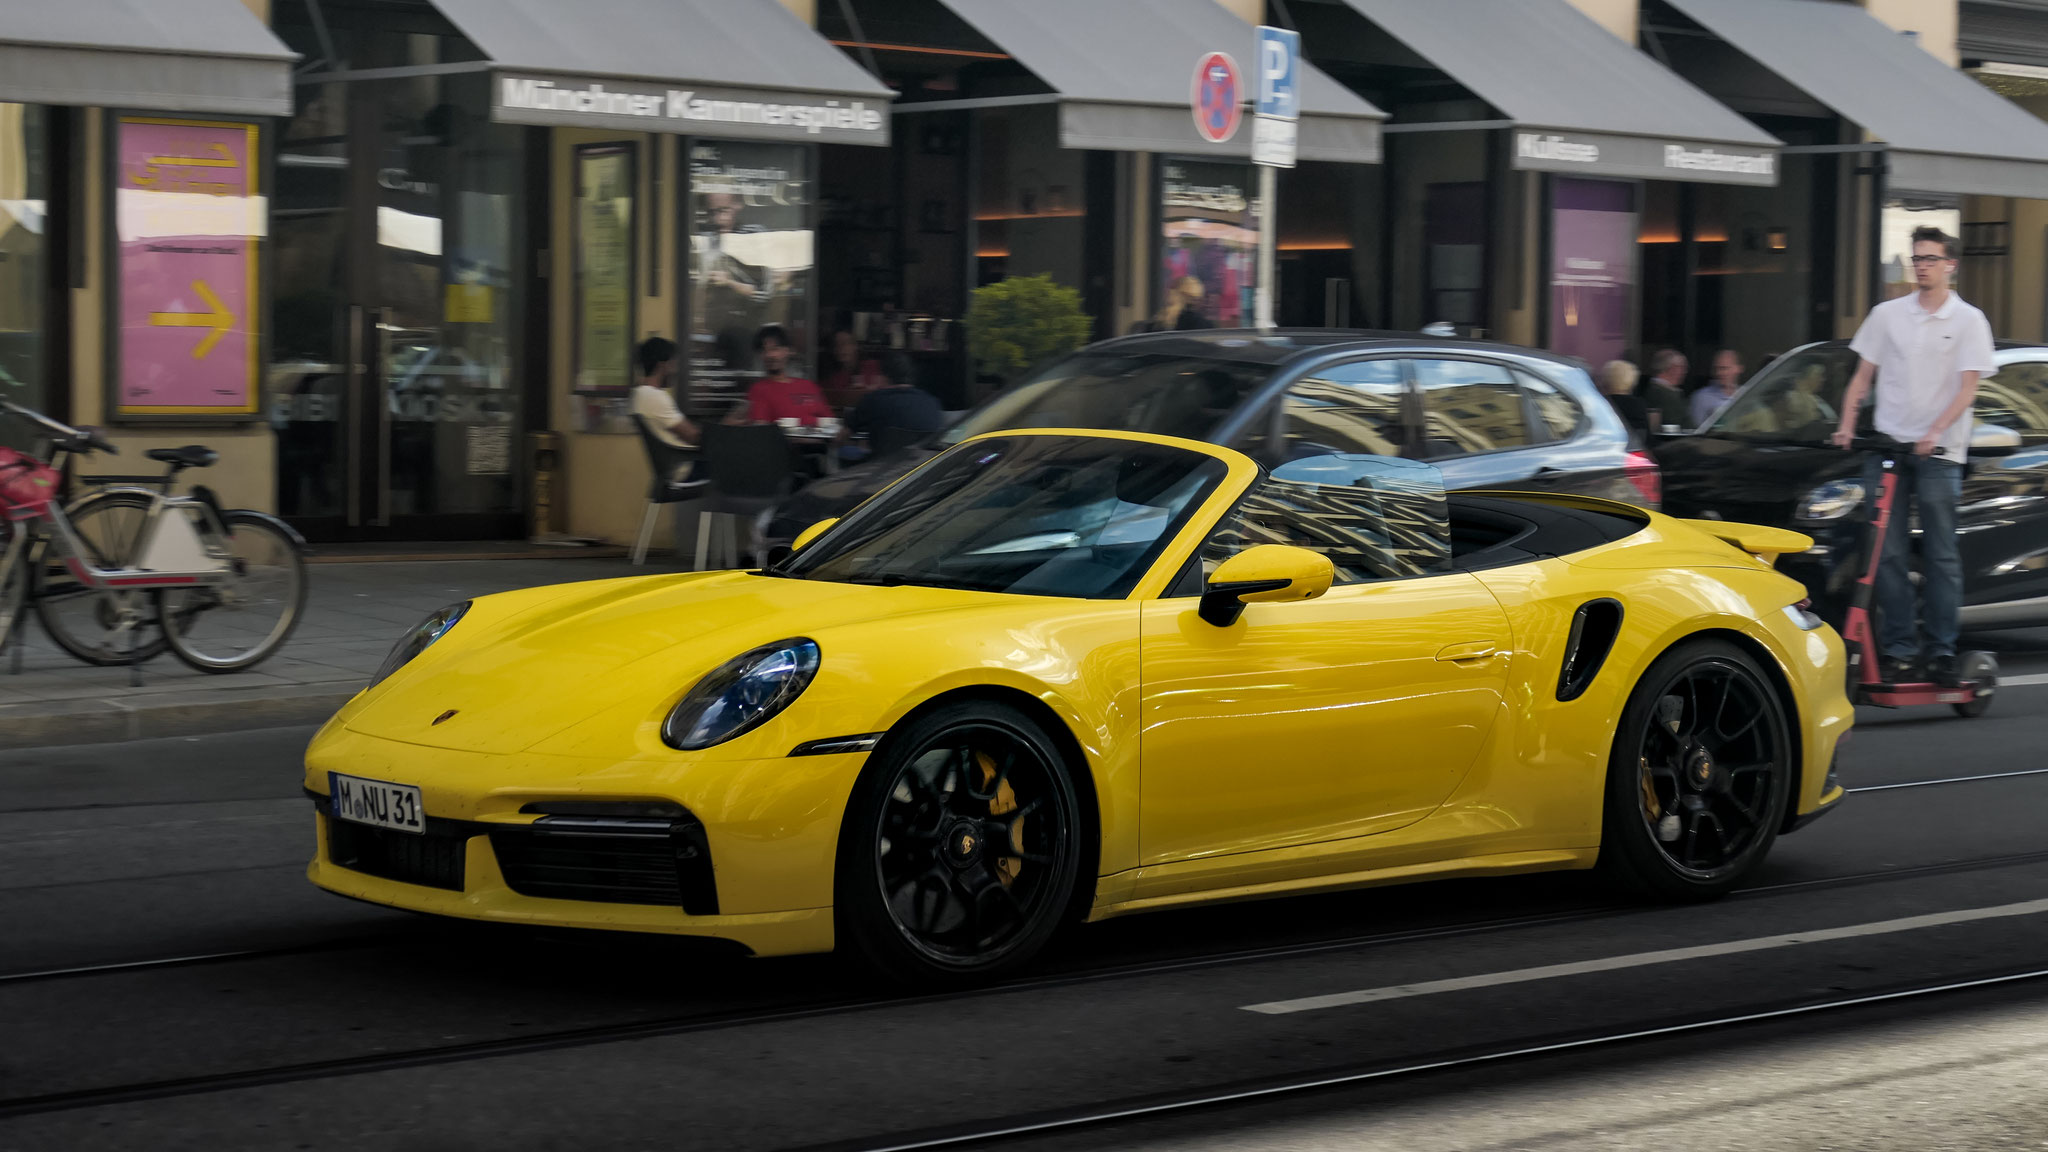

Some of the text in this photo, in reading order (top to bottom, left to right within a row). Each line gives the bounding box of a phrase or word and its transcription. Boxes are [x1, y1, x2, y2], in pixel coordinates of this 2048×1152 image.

[1261, 40, 1289, 103] P
[503, 77, 882, 134] Münchner Kammerspiele
[1517, 133, 1600, 163] Kulisse
[1663, 144, 1774, 174] Restaurant
[340, 780, 419, 827] M NU 31
